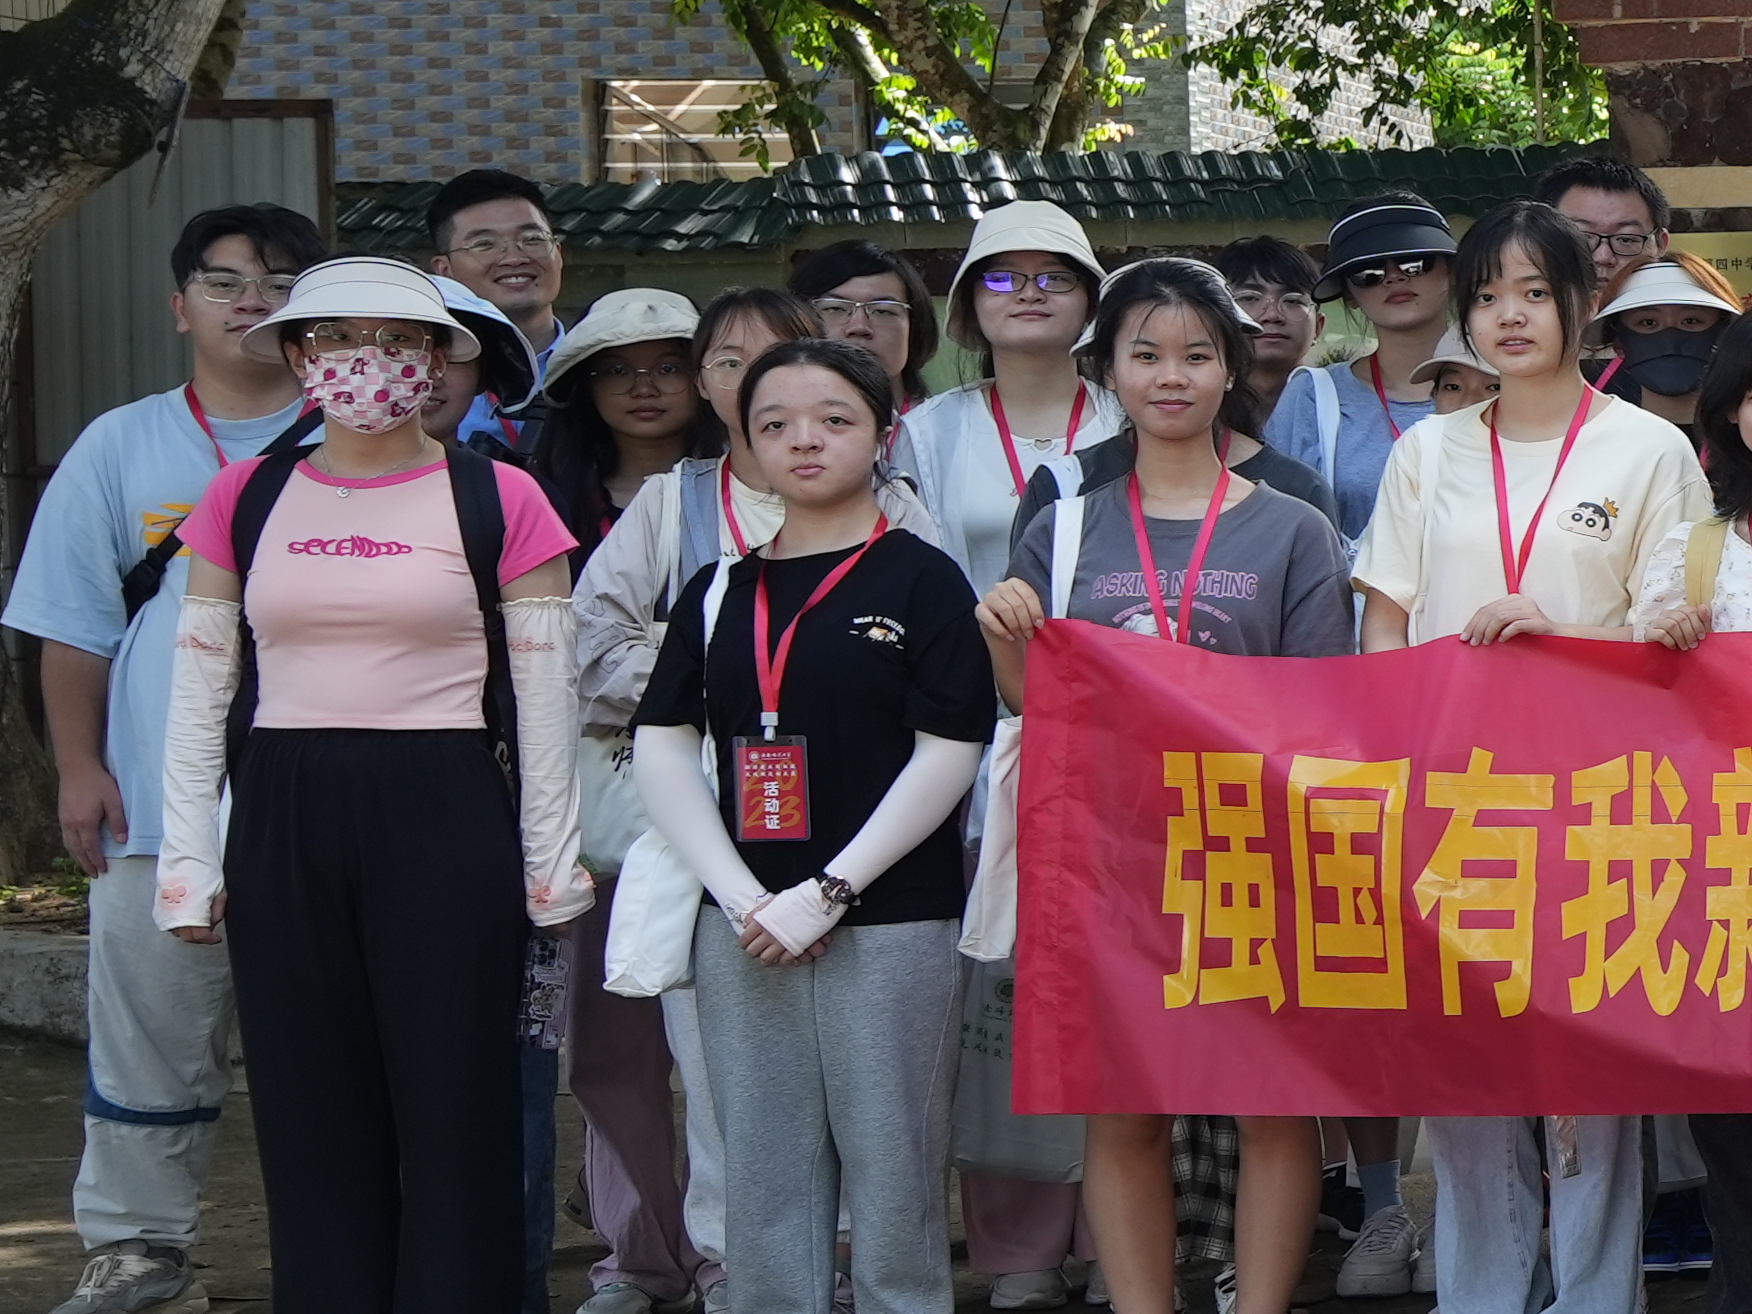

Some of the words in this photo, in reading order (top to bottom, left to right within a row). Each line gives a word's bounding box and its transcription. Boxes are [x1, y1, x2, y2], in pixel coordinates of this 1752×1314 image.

[1170, 569, 1259, 601] NTHING
[763, 780, 781, 830] 活动证
